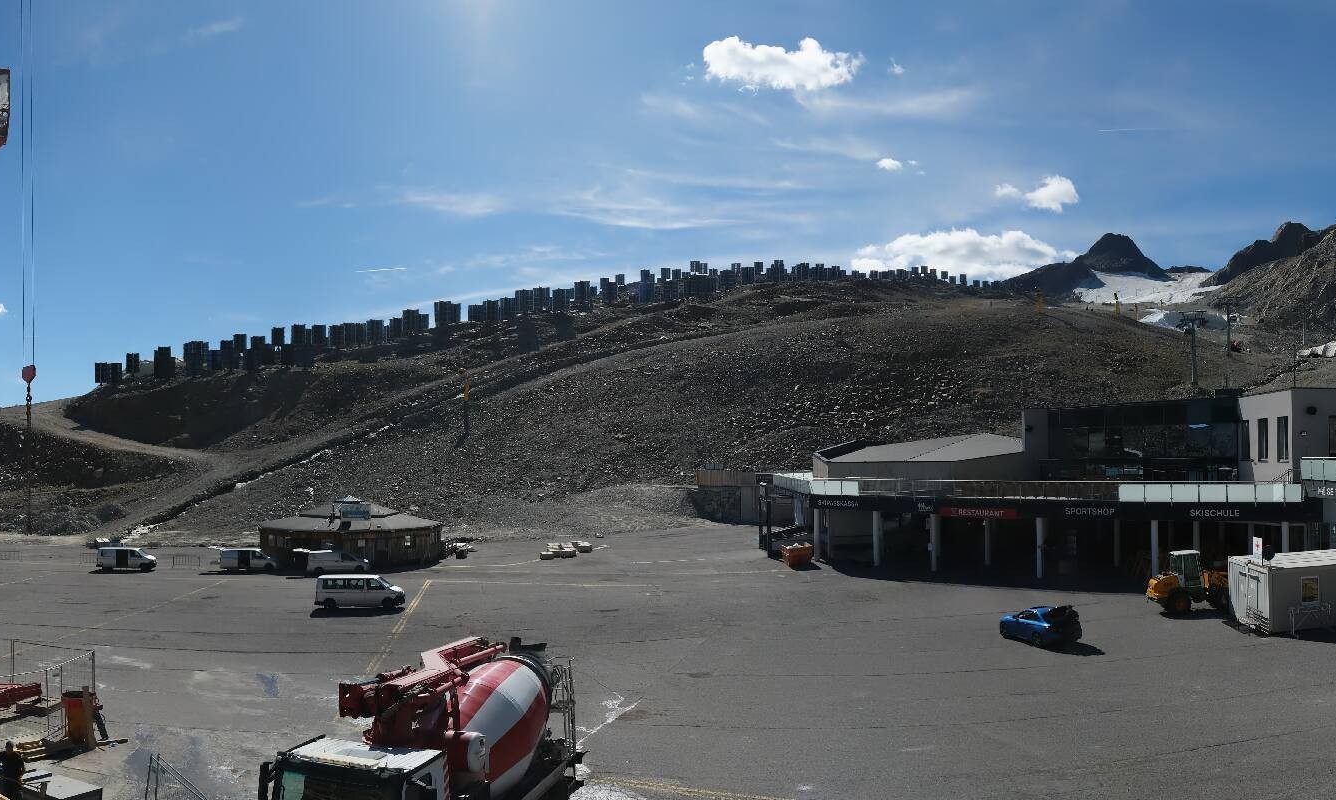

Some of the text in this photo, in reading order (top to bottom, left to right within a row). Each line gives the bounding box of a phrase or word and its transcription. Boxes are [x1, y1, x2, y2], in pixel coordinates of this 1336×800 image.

[958, 508, 1005, 517] RESTAURANT
[1065, 507, 1115, 516] SPORTSHOP
[1190, 509, 1240, 517] SKISCHULE
